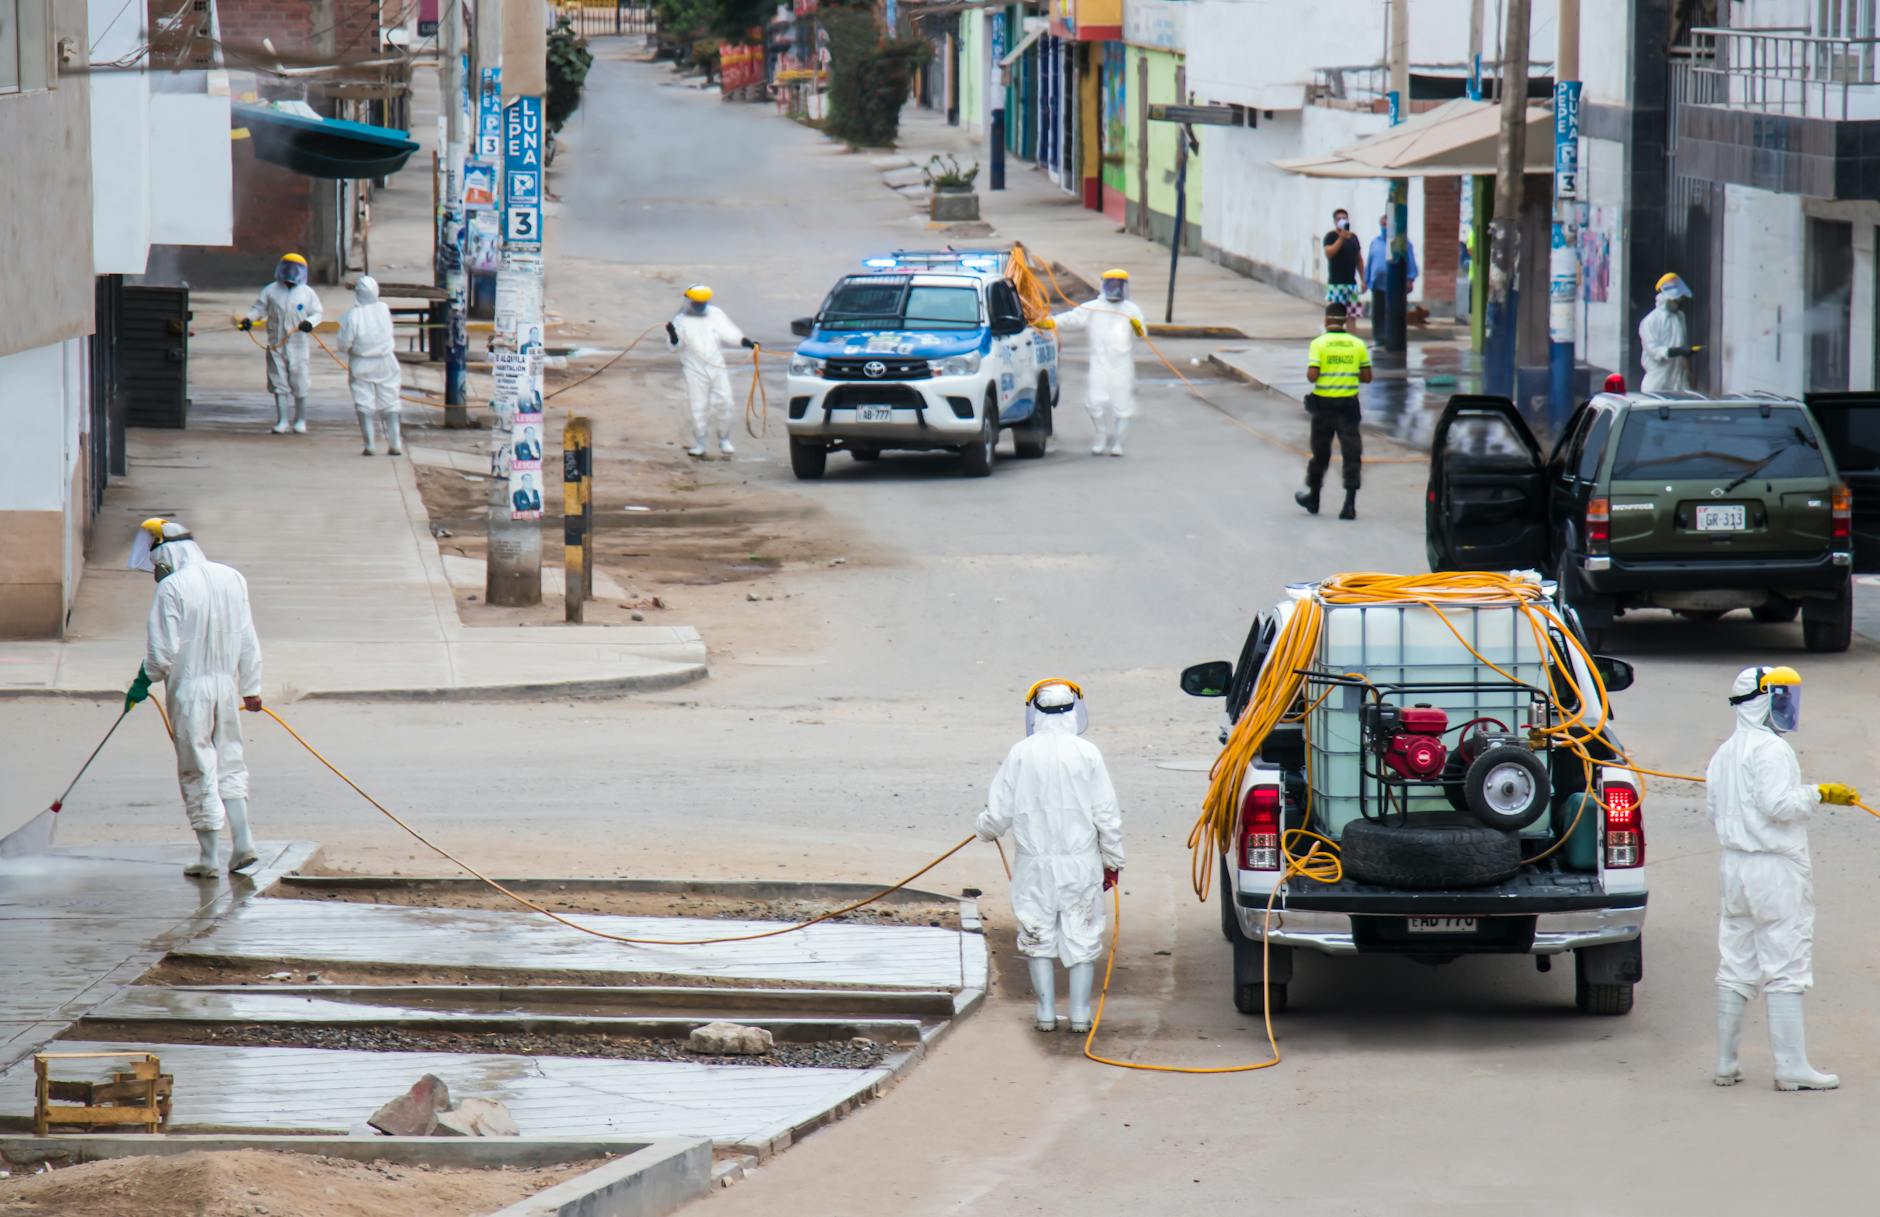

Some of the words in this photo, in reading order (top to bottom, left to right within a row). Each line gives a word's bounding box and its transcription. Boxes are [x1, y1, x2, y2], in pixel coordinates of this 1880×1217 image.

[508, 106, 522, 156] EPE
[523, 99, 538, 165] LUNA
[1558, 82, 1568, 133] PEPE
[1568, 89, 1578, 139] LUNA
[486, 139, 496, 153] 3
[1563, 175, 1575, 192] 3
[514, 211, 533, 236] 3
